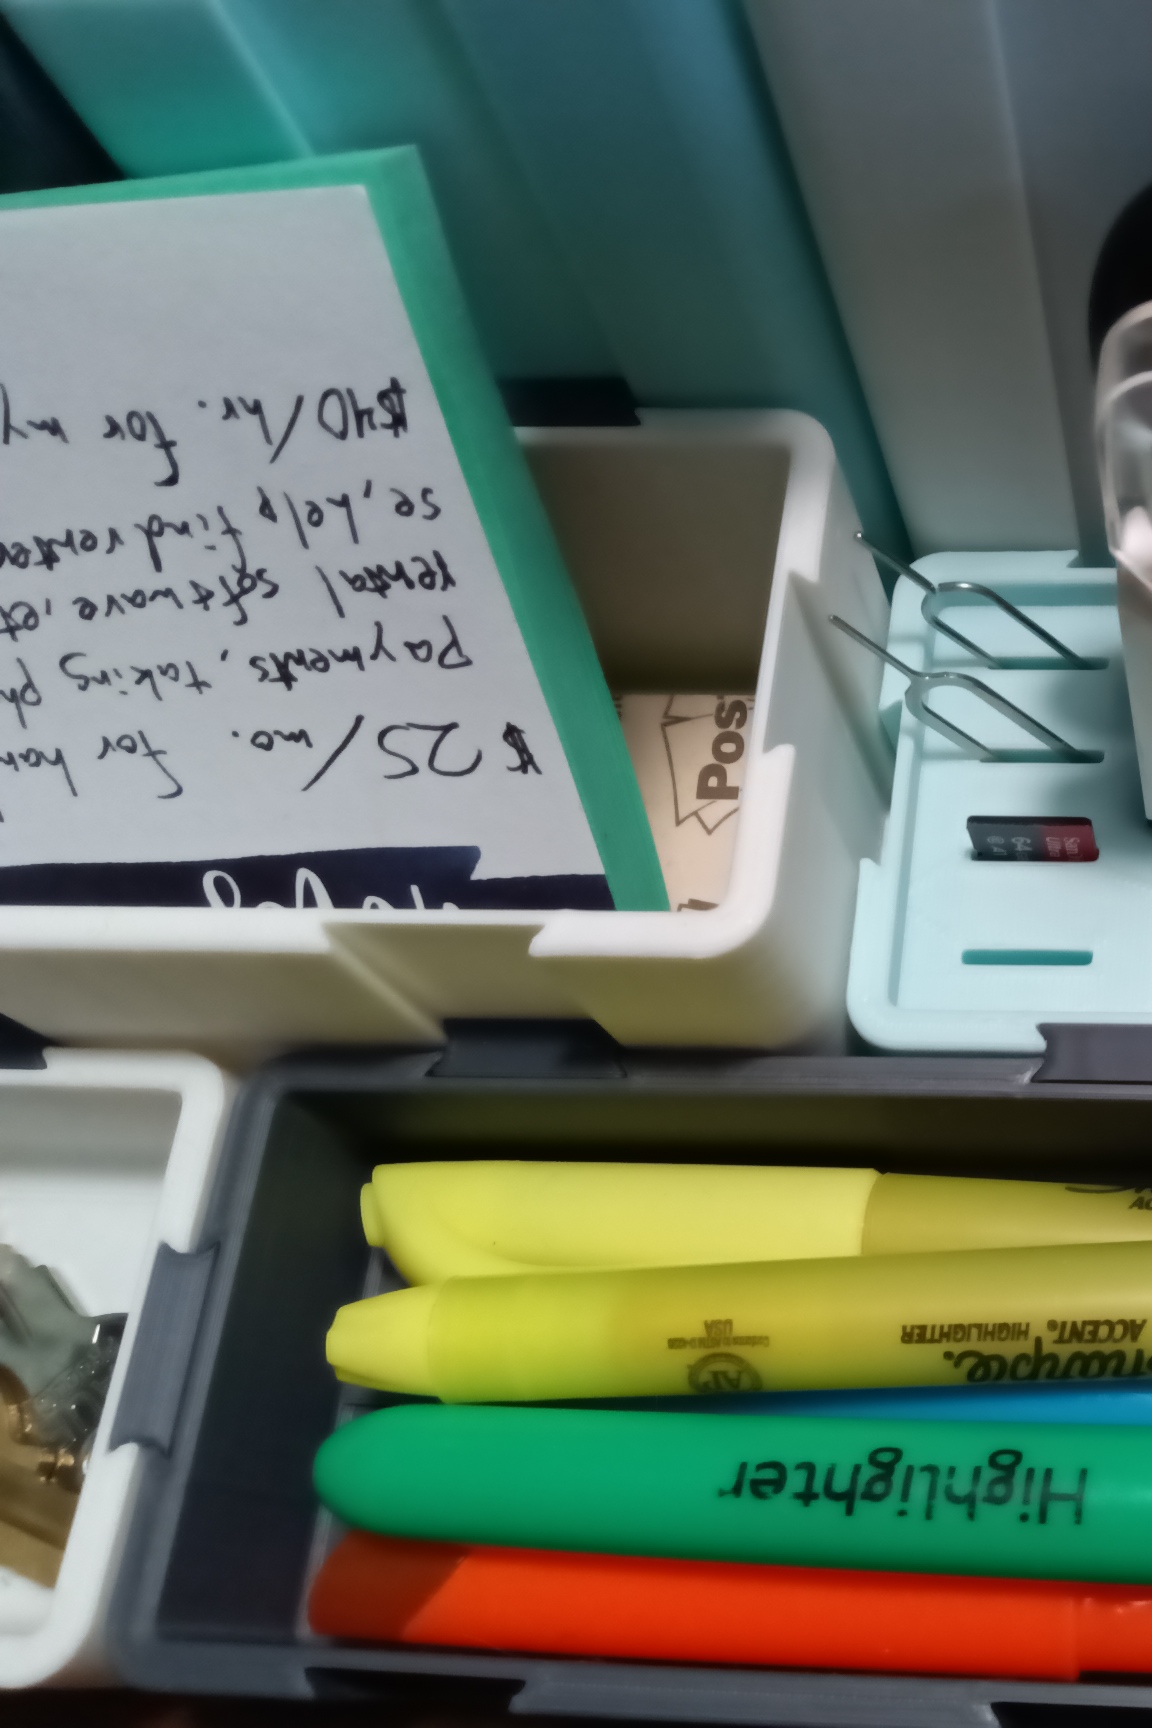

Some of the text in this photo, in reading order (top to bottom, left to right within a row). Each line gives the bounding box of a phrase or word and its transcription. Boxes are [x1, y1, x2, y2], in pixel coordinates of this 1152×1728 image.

[0, 383, 68, 444] my
[103, 411, 180, 485] for
[134, 503, 244, 570] find
[256, 485, 358, 546] help
[317, 549, 457, 616] rental
[58, 653, 210, 701] taking
[96, 730, 184, 799] for
[695, 695, 748, 801] Pos
[900, 1321, 1030, 1345] HIGHLIGHTER
[718, 1447, 1090, 1526] Highlighter
